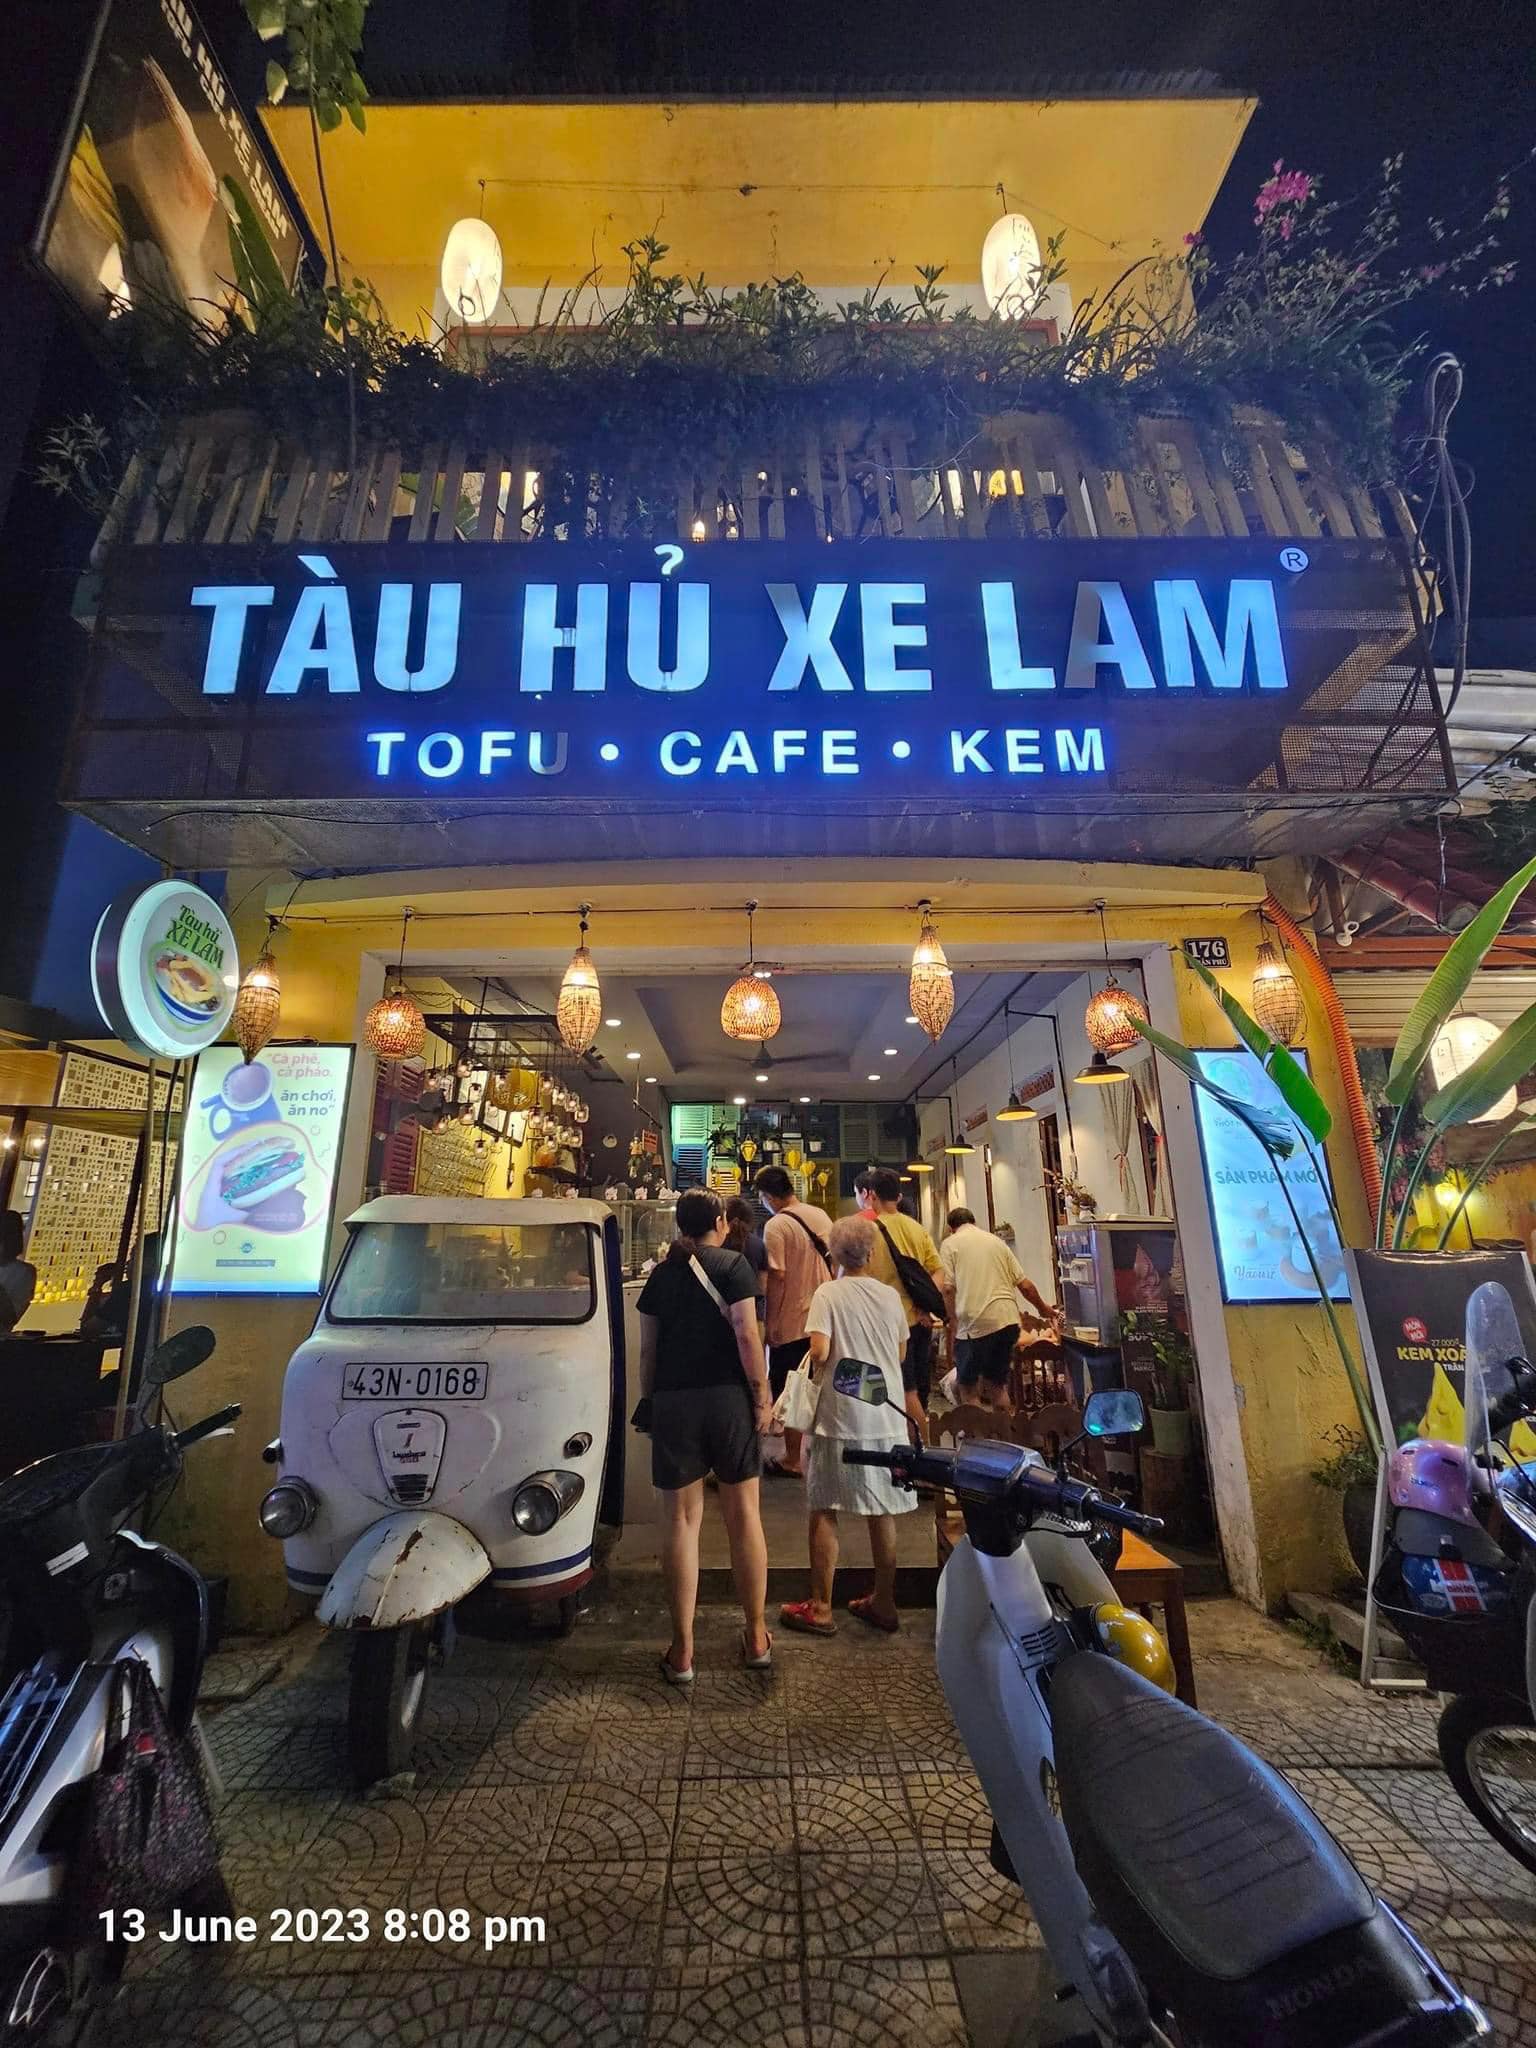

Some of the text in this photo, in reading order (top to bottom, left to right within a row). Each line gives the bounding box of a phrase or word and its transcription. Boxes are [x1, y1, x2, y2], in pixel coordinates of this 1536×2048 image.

[190, 554, 462, 693] TÀU
[519, 543, 710, 692] HỦ
[764, 582, 933, 691] XE
[981, 579, 1288, 690] LAM
[367, 728, 1106, 778] TOFU CAFE KEM
[179, 904, 202, 933] Tàu
[166, 919, 224, 969] XE LAM
[1188, 941, 1225, 958] 176
[1397, 1346, 1434, 1361] KEM
